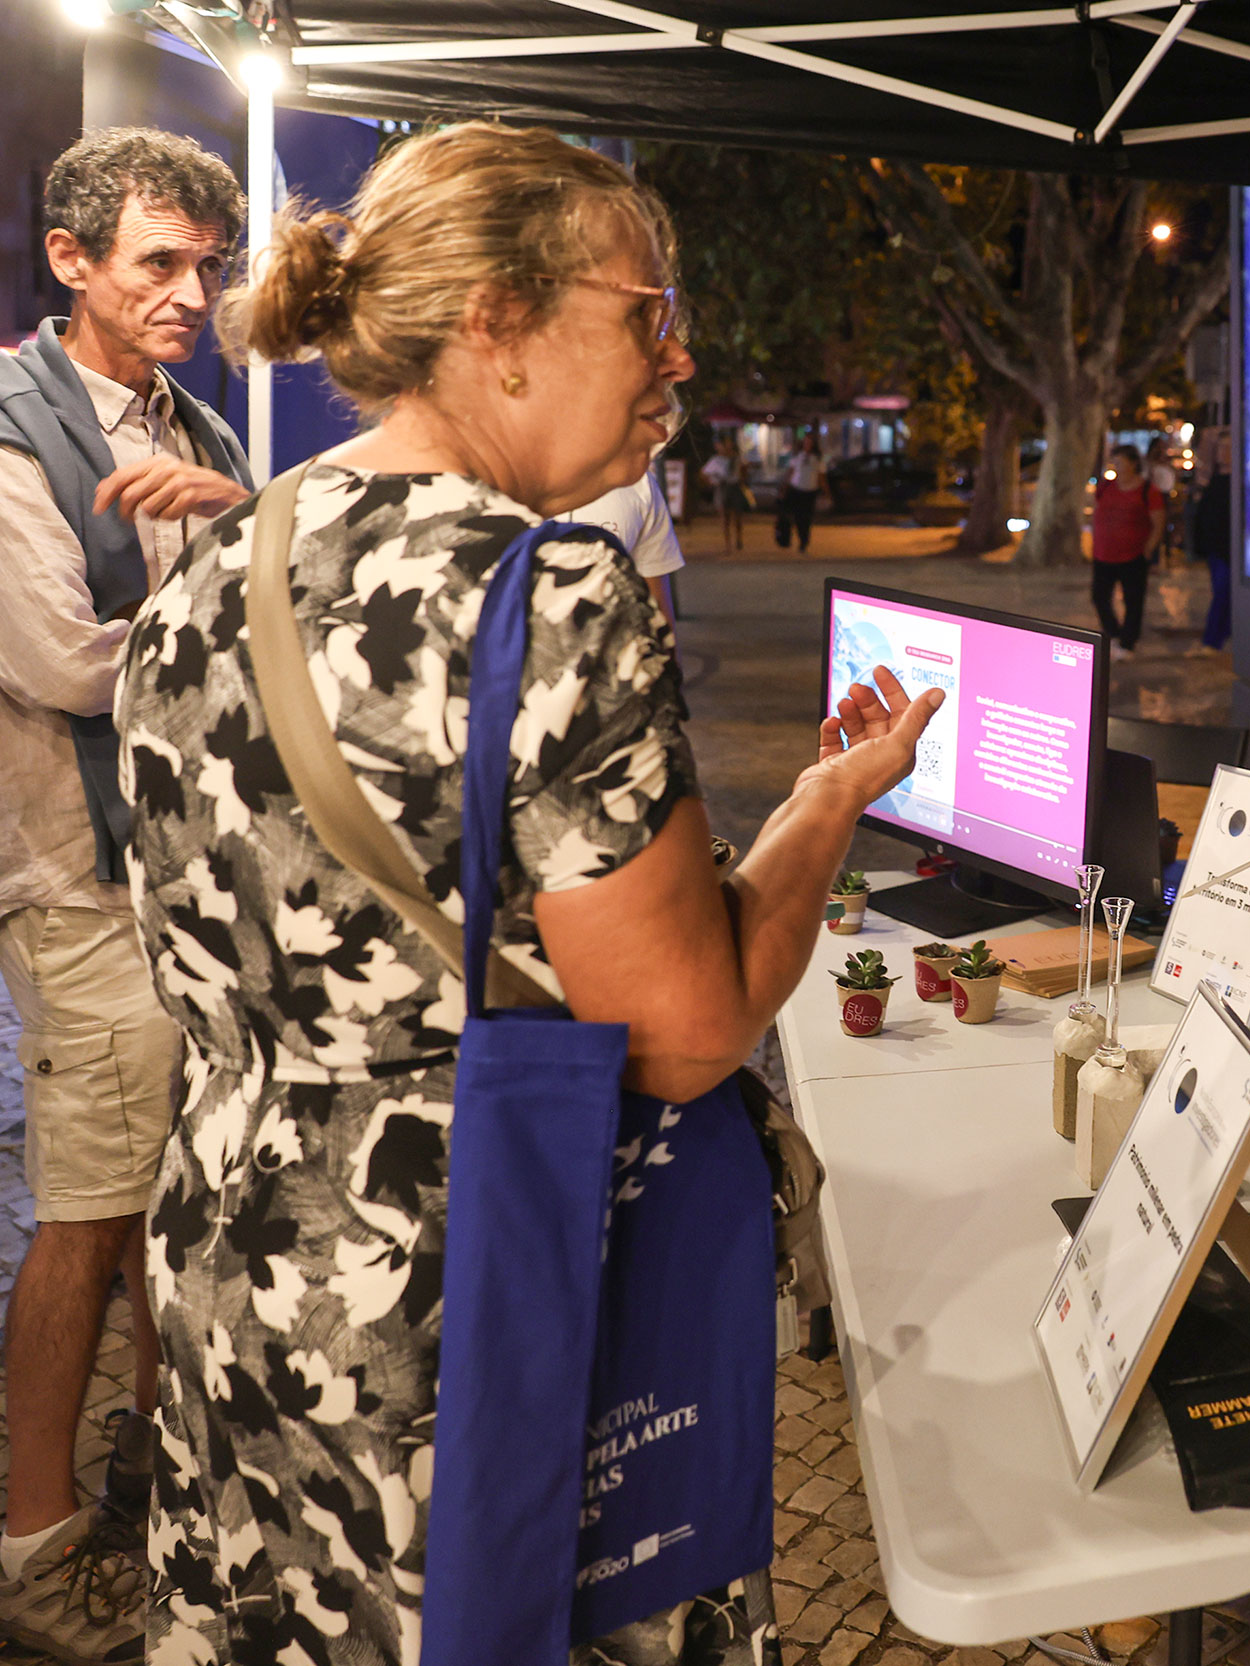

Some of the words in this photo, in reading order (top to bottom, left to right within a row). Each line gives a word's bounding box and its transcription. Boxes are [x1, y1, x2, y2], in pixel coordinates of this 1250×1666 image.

[912, 667, 955, 690] CONECTOR
[847, 1001, 865, 1014] EU
[845, 1011, 878, 1026] DRES
[640, 1403, 699, 1446] ARTE
